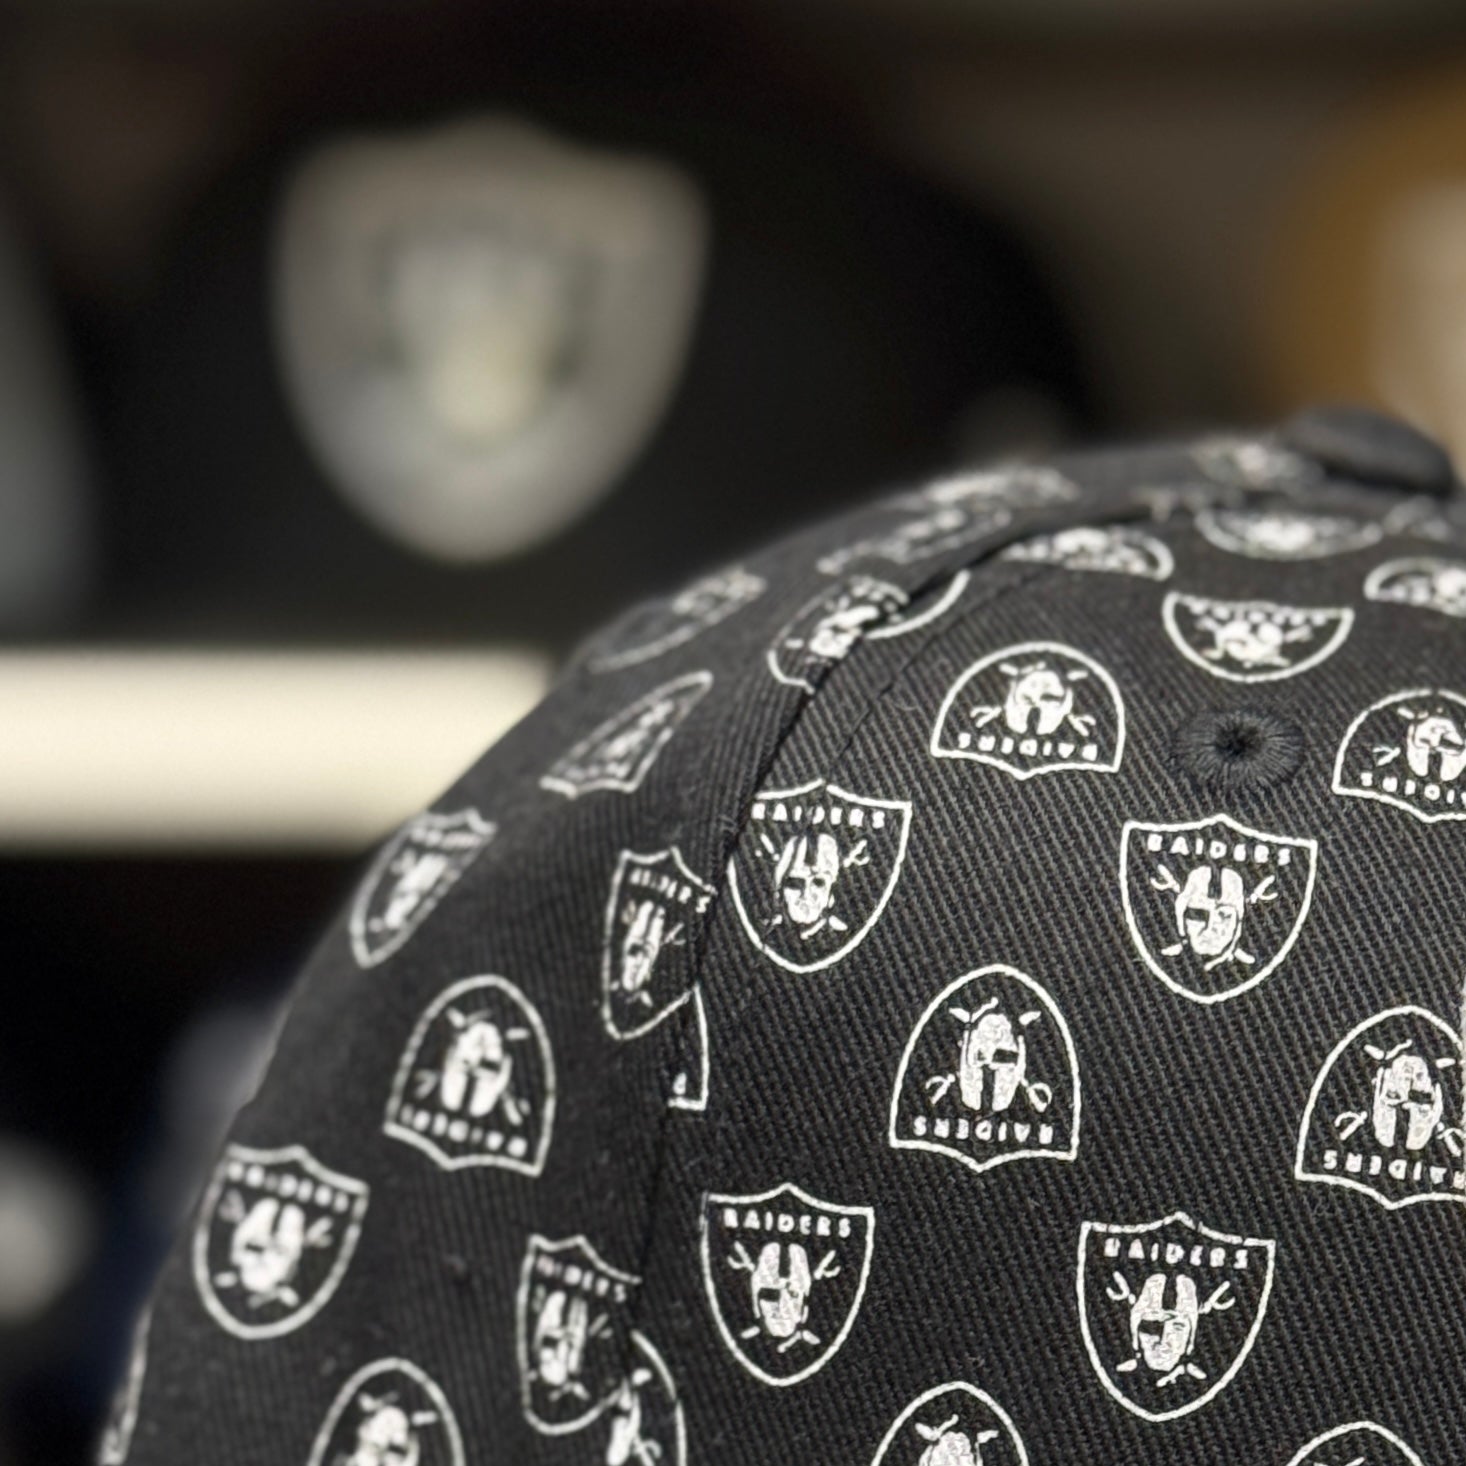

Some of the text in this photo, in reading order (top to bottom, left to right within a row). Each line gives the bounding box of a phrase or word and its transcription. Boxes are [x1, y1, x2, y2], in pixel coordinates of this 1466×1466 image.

[957, 731, 1098, 761] RAIDERS
[750, 802, 886, 831] RAIDERS
[1146, 833, 1291, 866] RAIDERS
[913, 1117, 1054, 1144] RAIDERS
[723, 1208, 851, 1238] RAIDERS
[1103, 1238, 1248, 1269] RAIDERS
